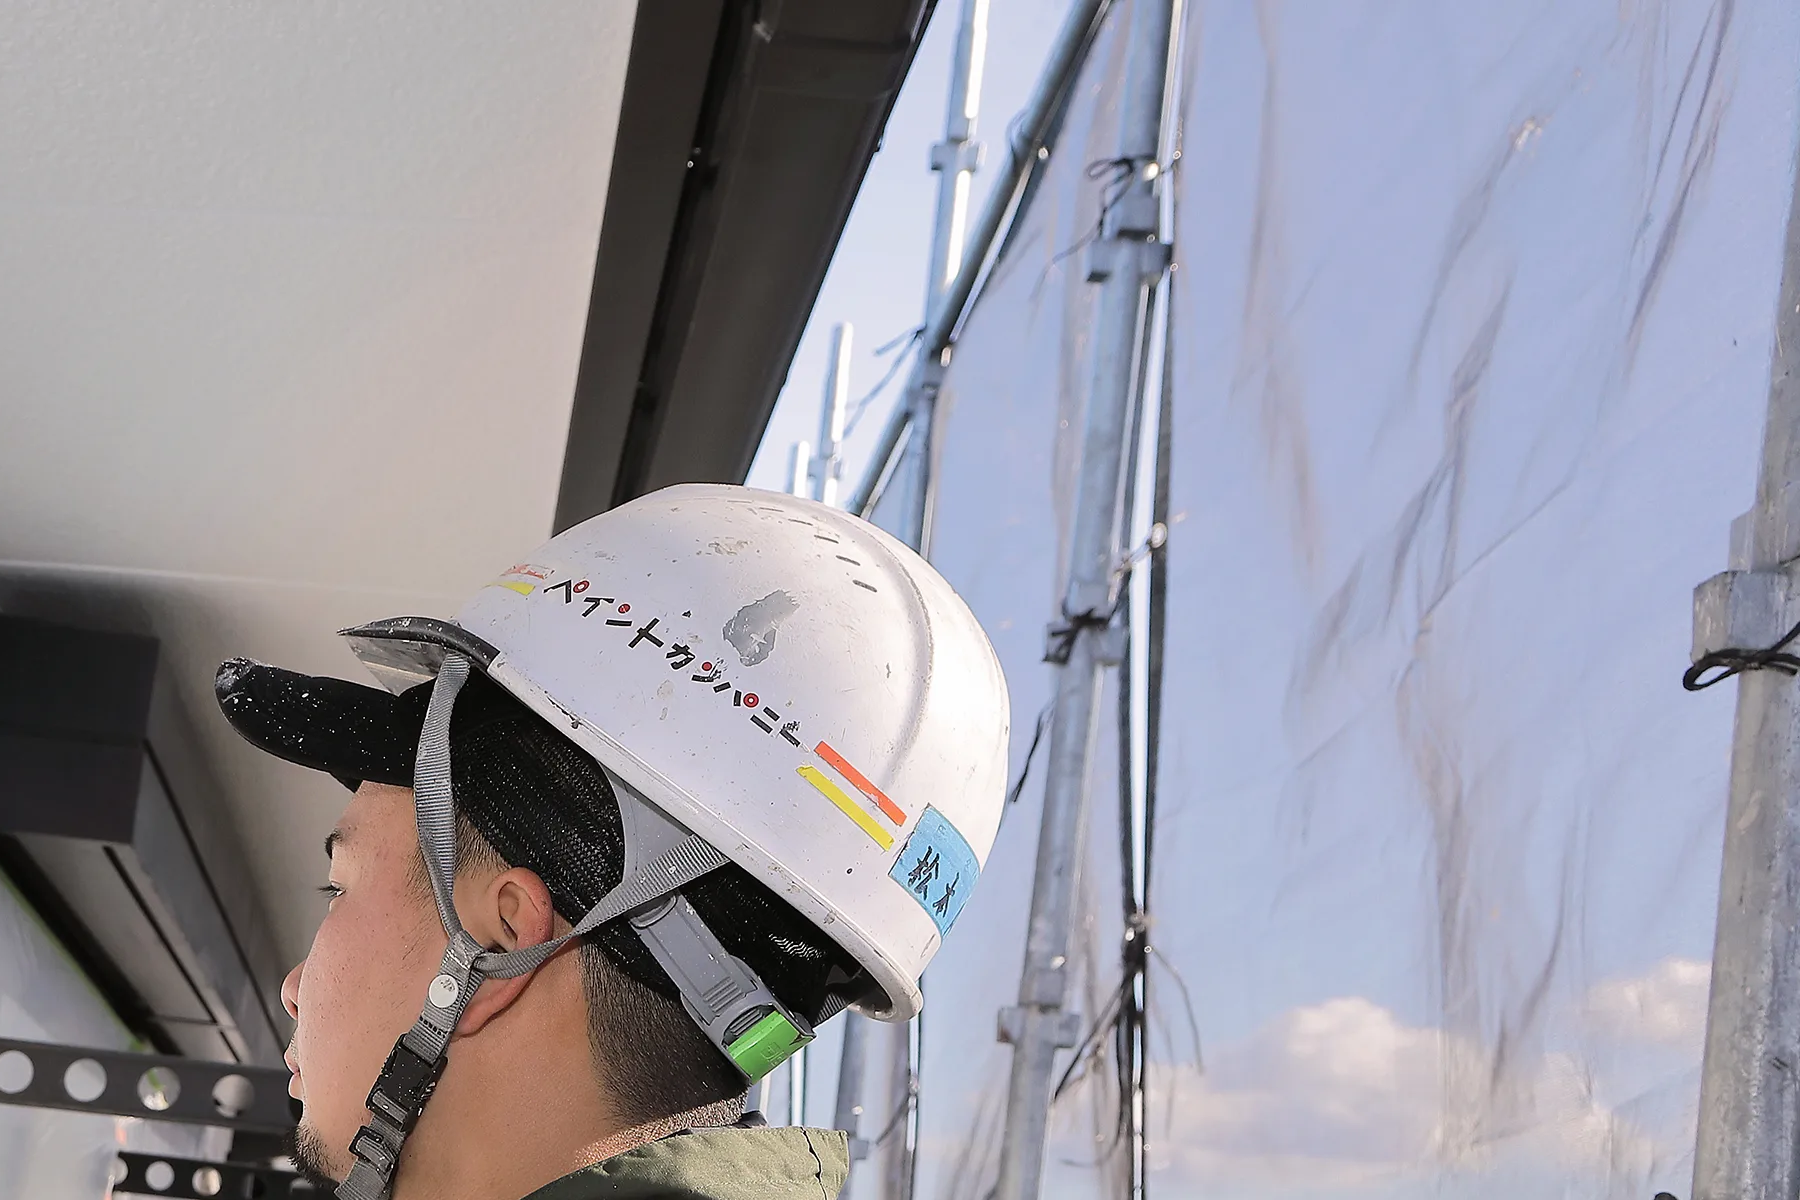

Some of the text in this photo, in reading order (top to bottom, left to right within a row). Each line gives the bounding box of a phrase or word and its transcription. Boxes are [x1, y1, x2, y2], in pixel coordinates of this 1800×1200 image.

[543, 579, 801, 747] ペイントカンパニー
